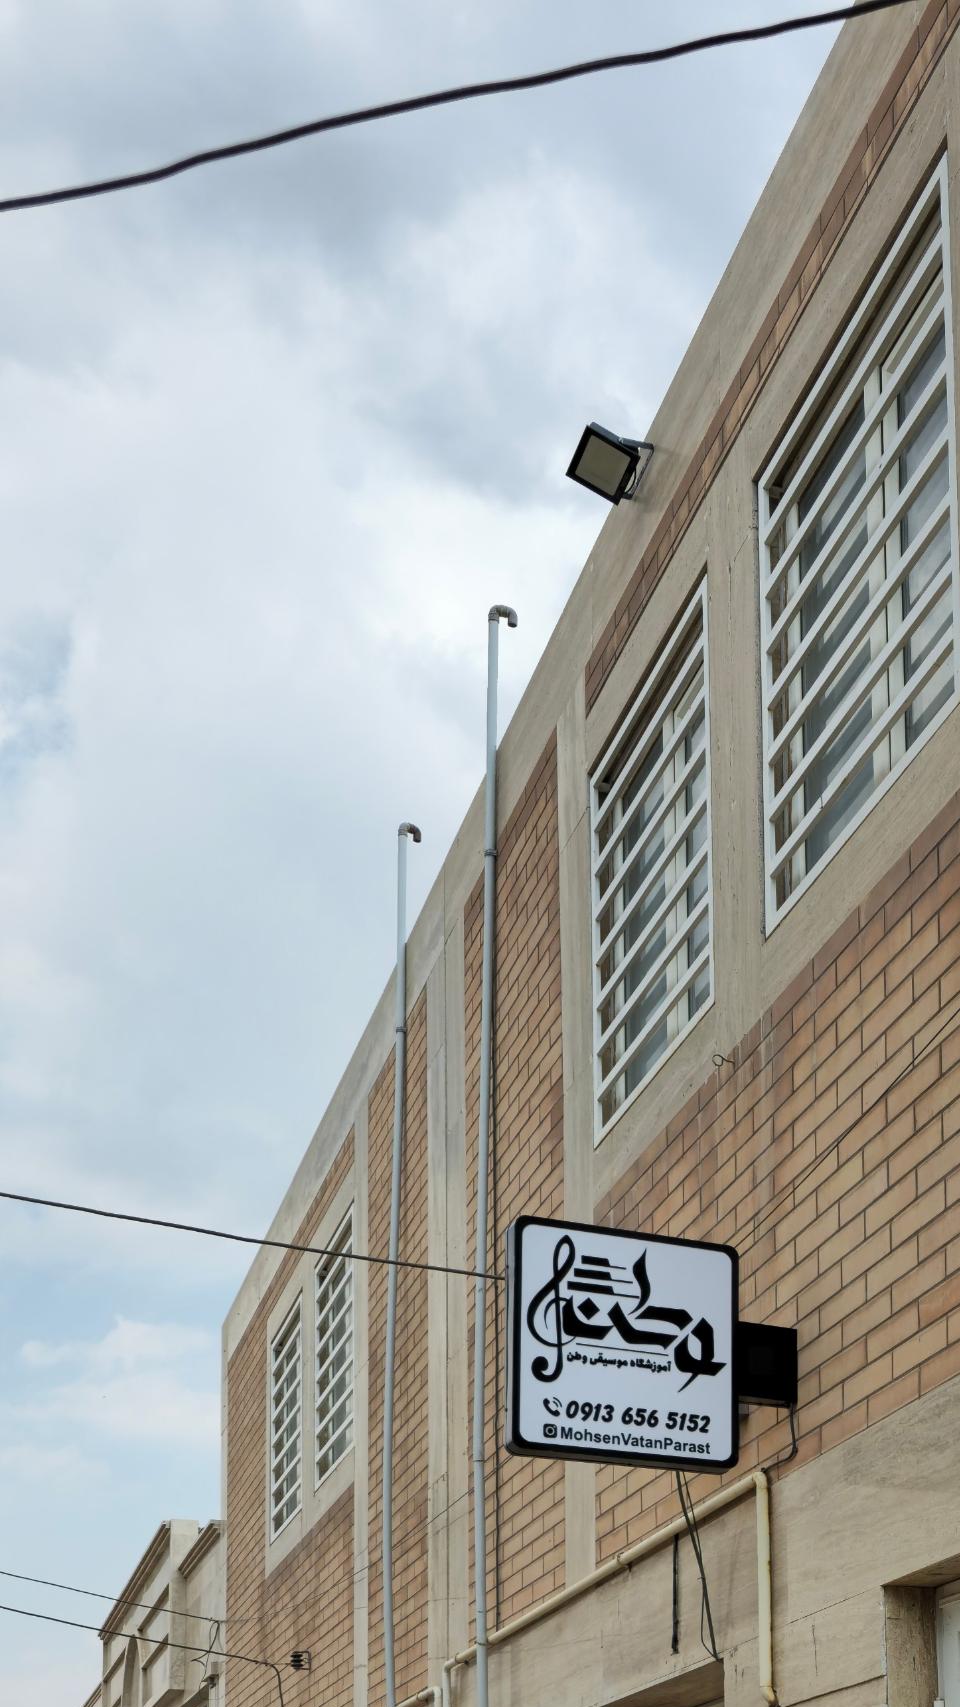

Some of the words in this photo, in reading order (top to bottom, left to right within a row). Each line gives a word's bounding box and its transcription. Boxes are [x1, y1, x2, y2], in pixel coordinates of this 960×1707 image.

[567, 1351, 588, 1365] وطن
[590, 1352, 628, 1368] موسیقی
[630, 1358, 672, 1374] آموزشگاه
[566, 1400, 615, 1423] 0913
[621, 1406, 659, 1428] 656
[665, 1411, 711, 1434] 5152
[560, 1426, 711, 1454] MohsenVatanParast
